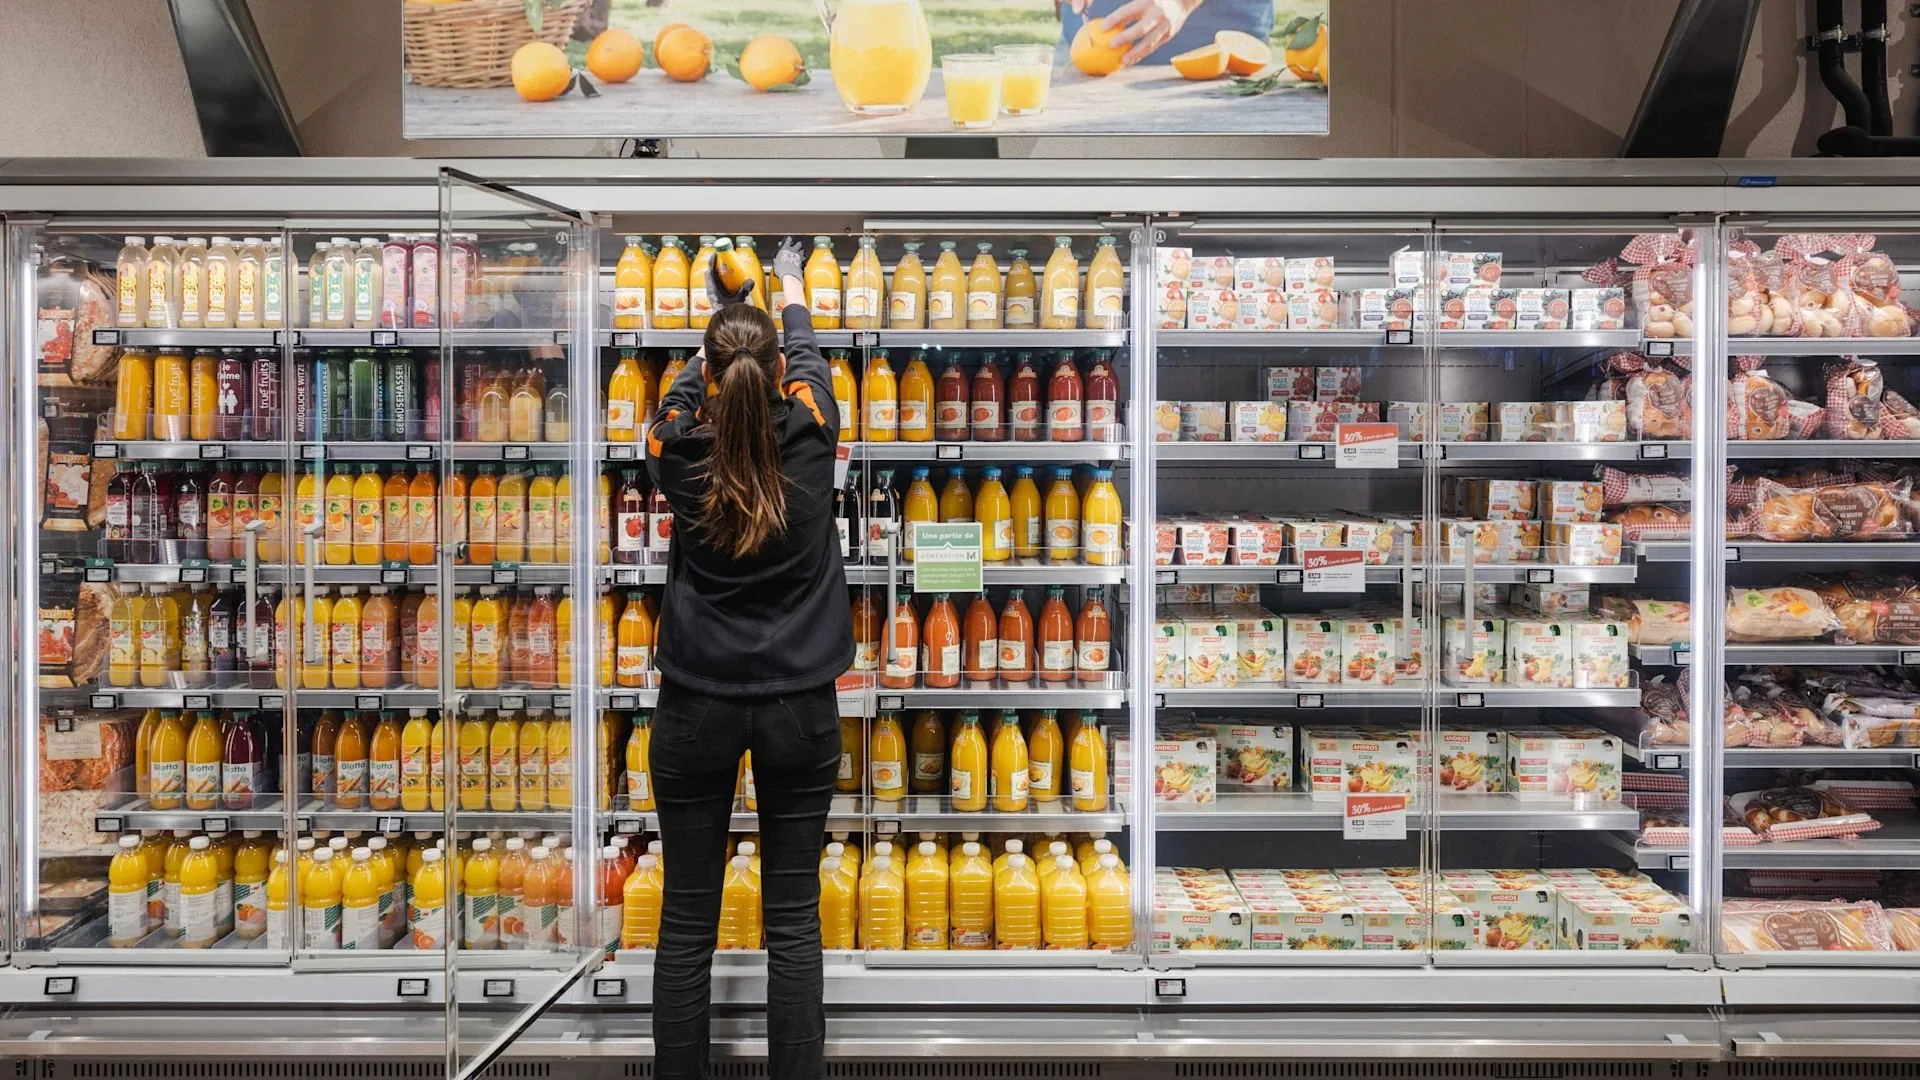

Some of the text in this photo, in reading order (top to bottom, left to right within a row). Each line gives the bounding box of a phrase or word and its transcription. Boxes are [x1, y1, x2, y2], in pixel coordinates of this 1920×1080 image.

[168, 362, 180, 408] true fruits
[258, 362, 270, 409] true fruits
[396, 364, 404, 434] GEMÜSEHASSER
[297, 387, 305, 432] ANZÜGLICHE
[1344, 431, 1363, 443] 30%
[1307, 555, 1328, 568] 30%
[153, 763, 178, 771] Biotta
[224, 765, 246, 773] Biotta
[1352, 802, 1371, 815] 30%
